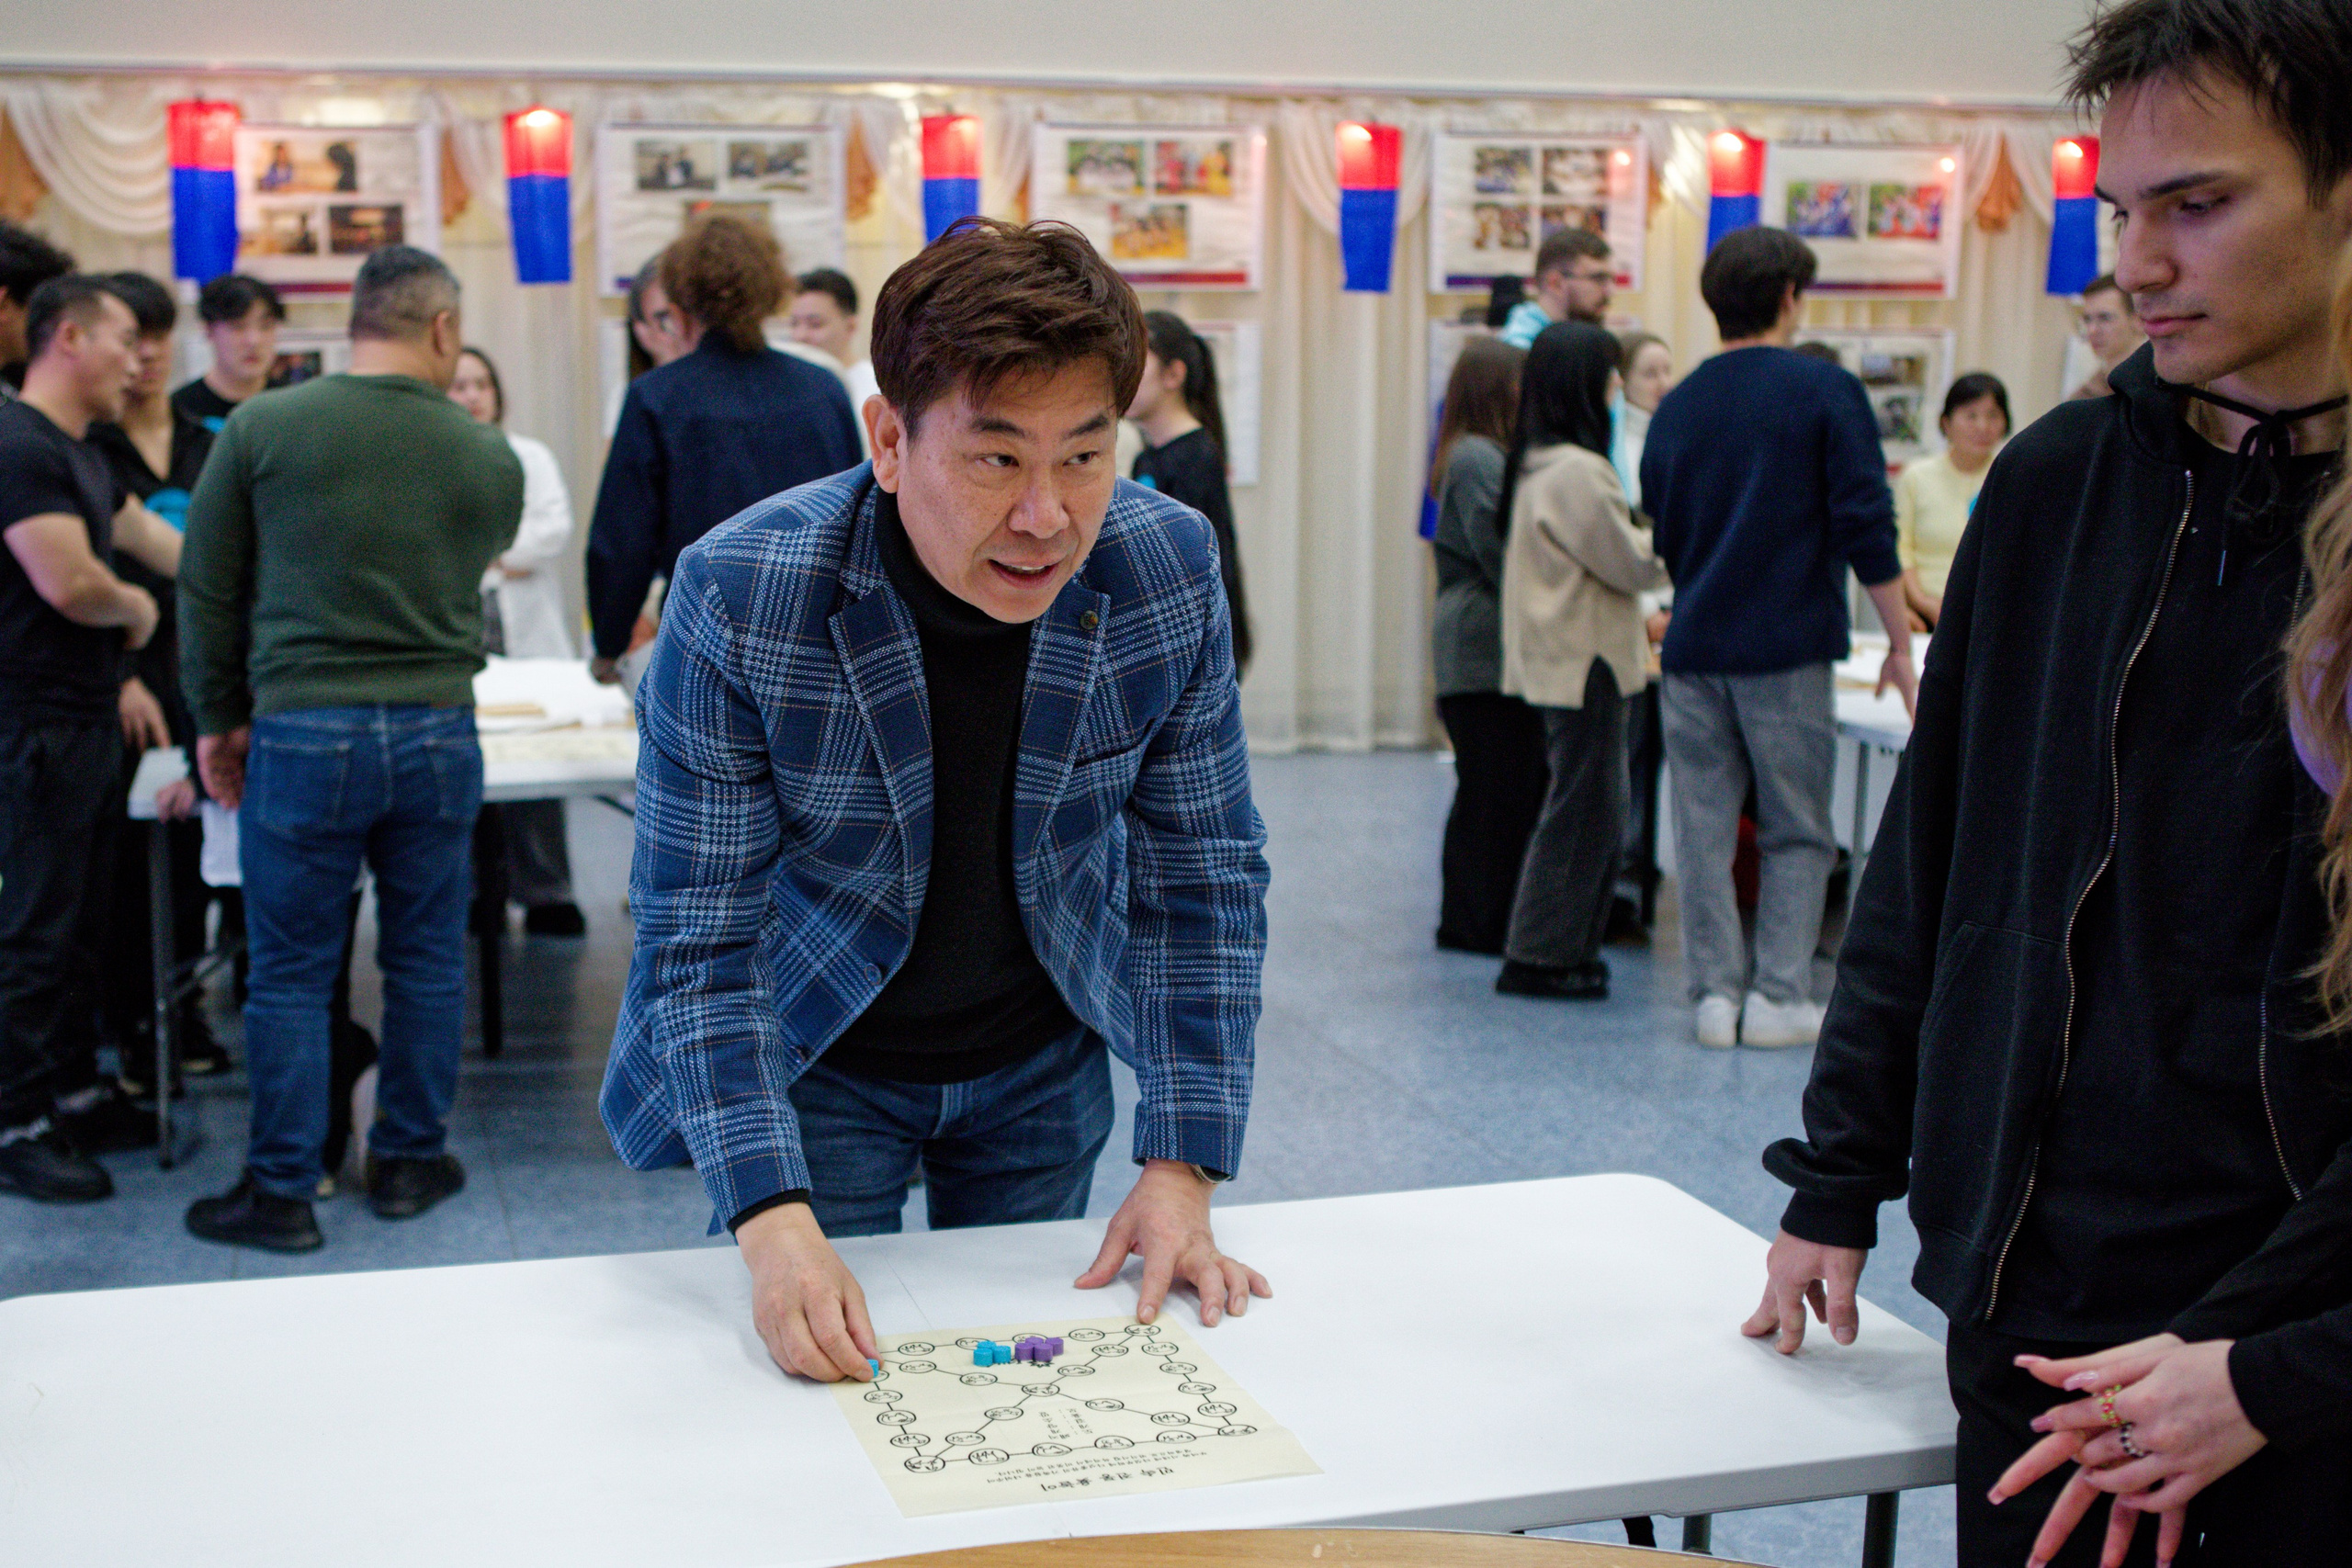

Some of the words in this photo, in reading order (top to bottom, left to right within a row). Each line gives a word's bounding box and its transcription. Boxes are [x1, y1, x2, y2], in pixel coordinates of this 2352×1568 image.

[1100, 1472, 1133, 1481] 전통
[1140, 1467, 1174, 1477] 민속
[1040, 1477, 1092, 1492] 윷놀이
